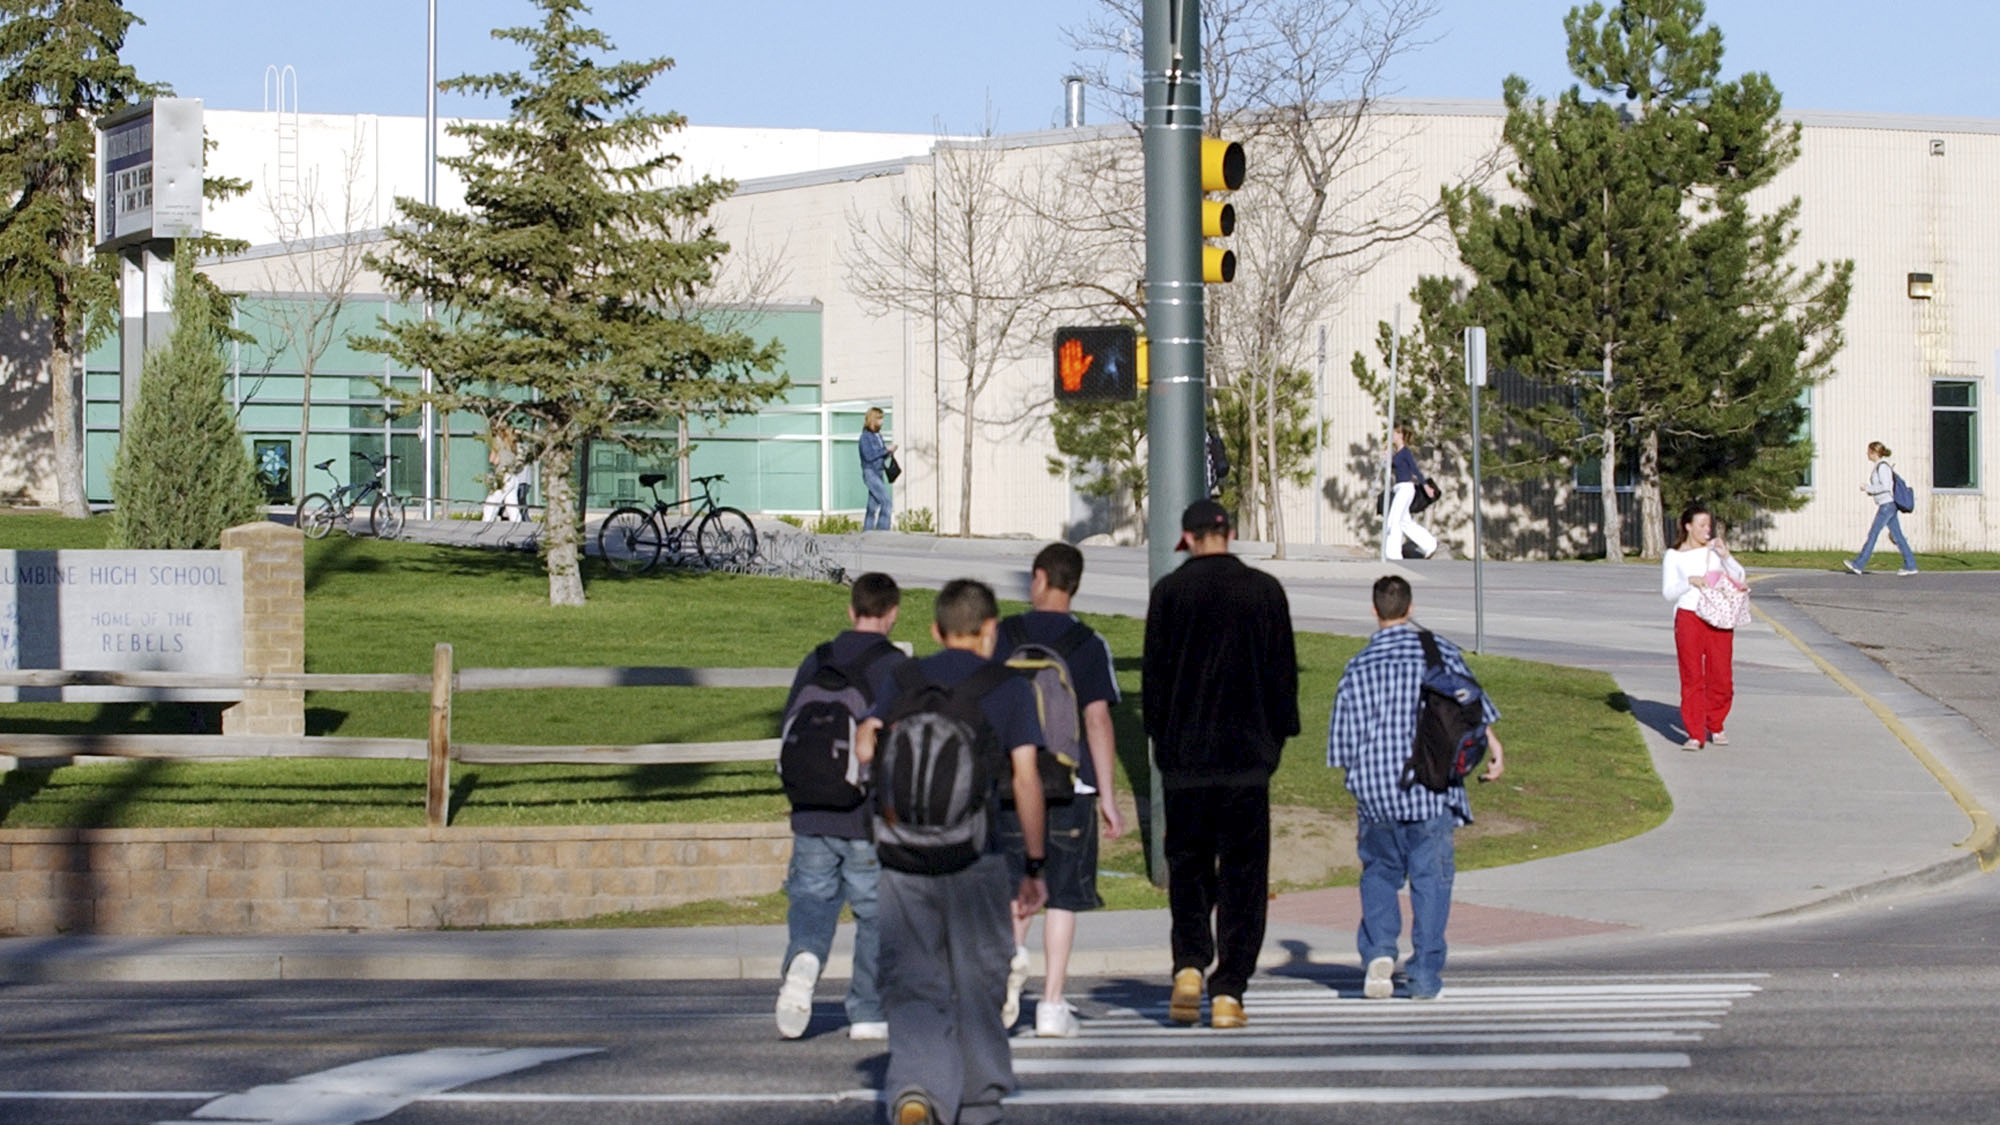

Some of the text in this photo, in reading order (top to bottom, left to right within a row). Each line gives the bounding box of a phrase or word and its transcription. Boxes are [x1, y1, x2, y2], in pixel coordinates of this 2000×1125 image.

[0, 566, 227, 585] UMBINE HIGH SCHOOL
[91, 611, 193, 626] HOME OF THE
[102, 633, 184, 652] REBELS
